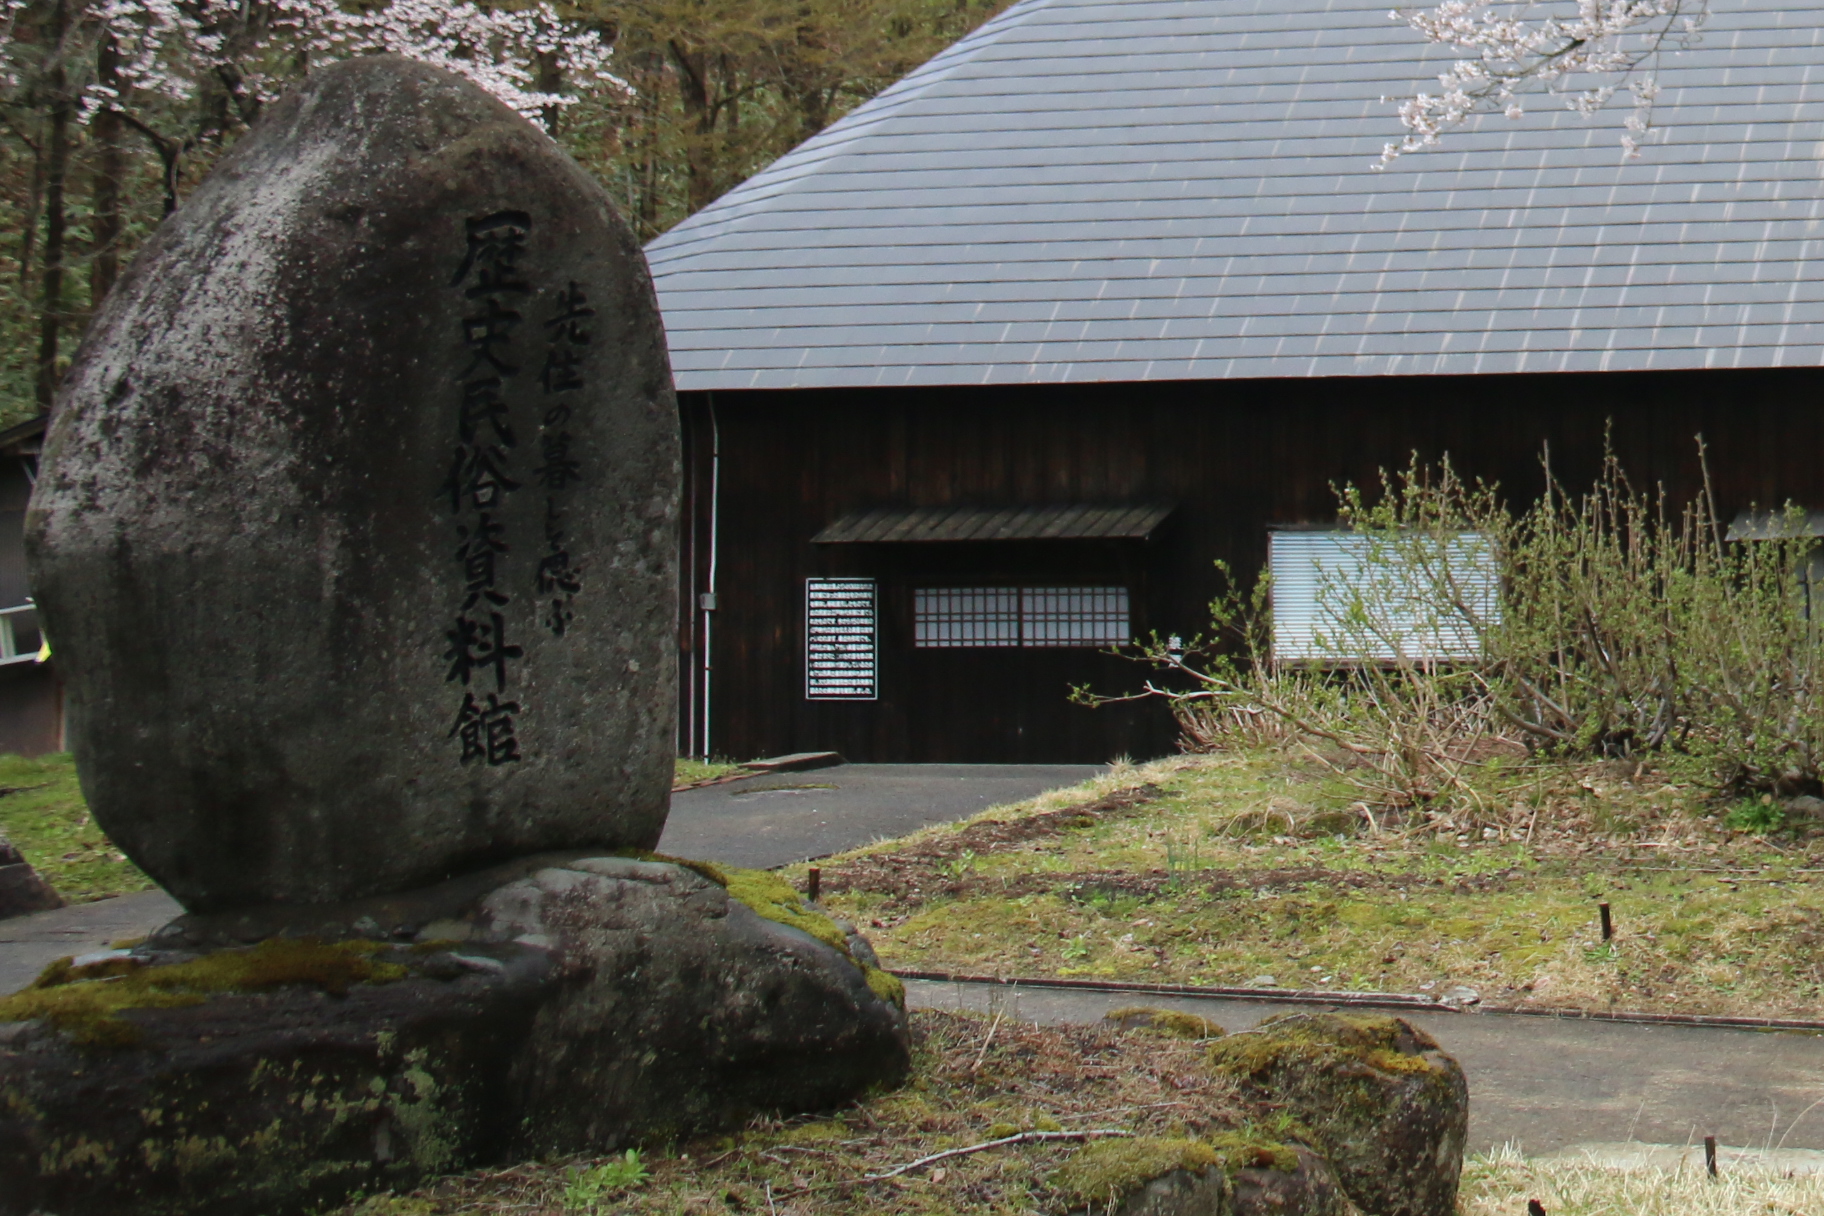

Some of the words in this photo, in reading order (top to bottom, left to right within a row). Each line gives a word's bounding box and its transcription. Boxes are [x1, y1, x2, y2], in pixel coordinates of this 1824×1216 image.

[438, 211, 532, 766] 歴史民俗資料館
